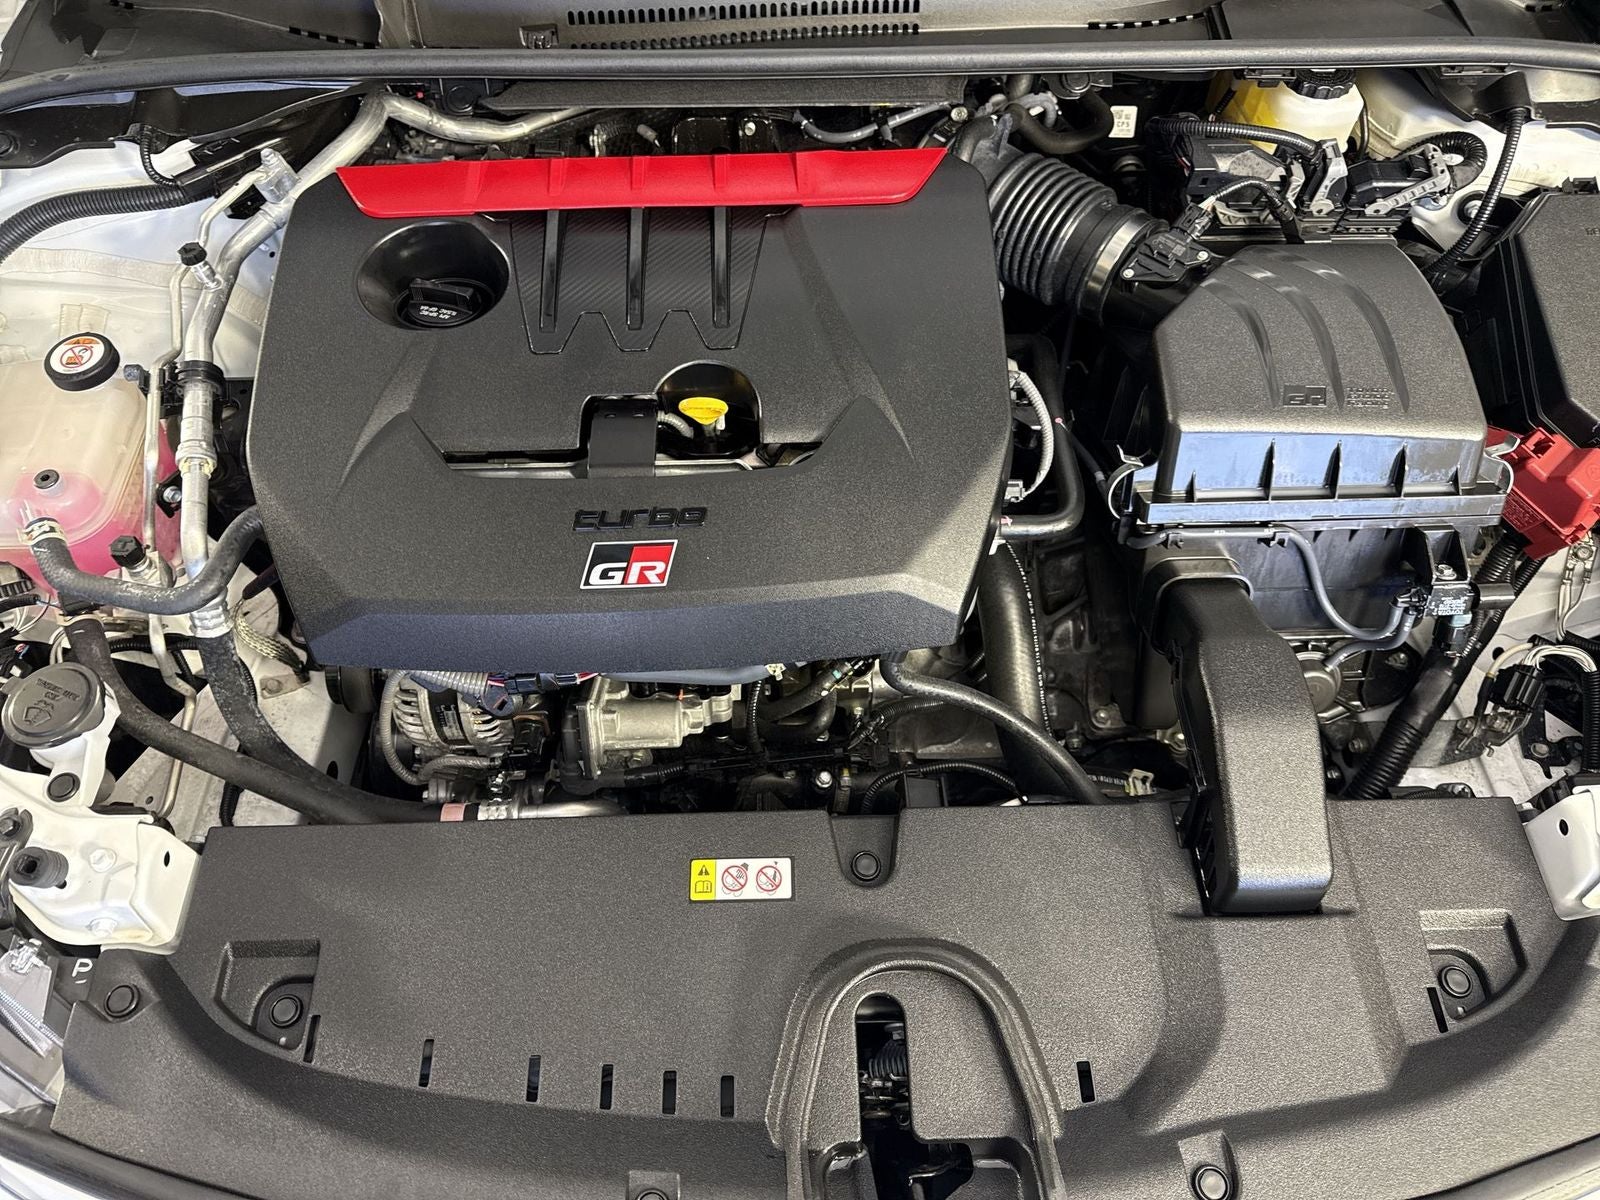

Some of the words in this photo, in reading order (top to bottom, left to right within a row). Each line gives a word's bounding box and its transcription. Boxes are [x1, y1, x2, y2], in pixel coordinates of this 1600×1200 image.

[573, 507, 707, 531] turbo
[588, 560, 666, 585] GR
[71, 957, 94, 978] P
